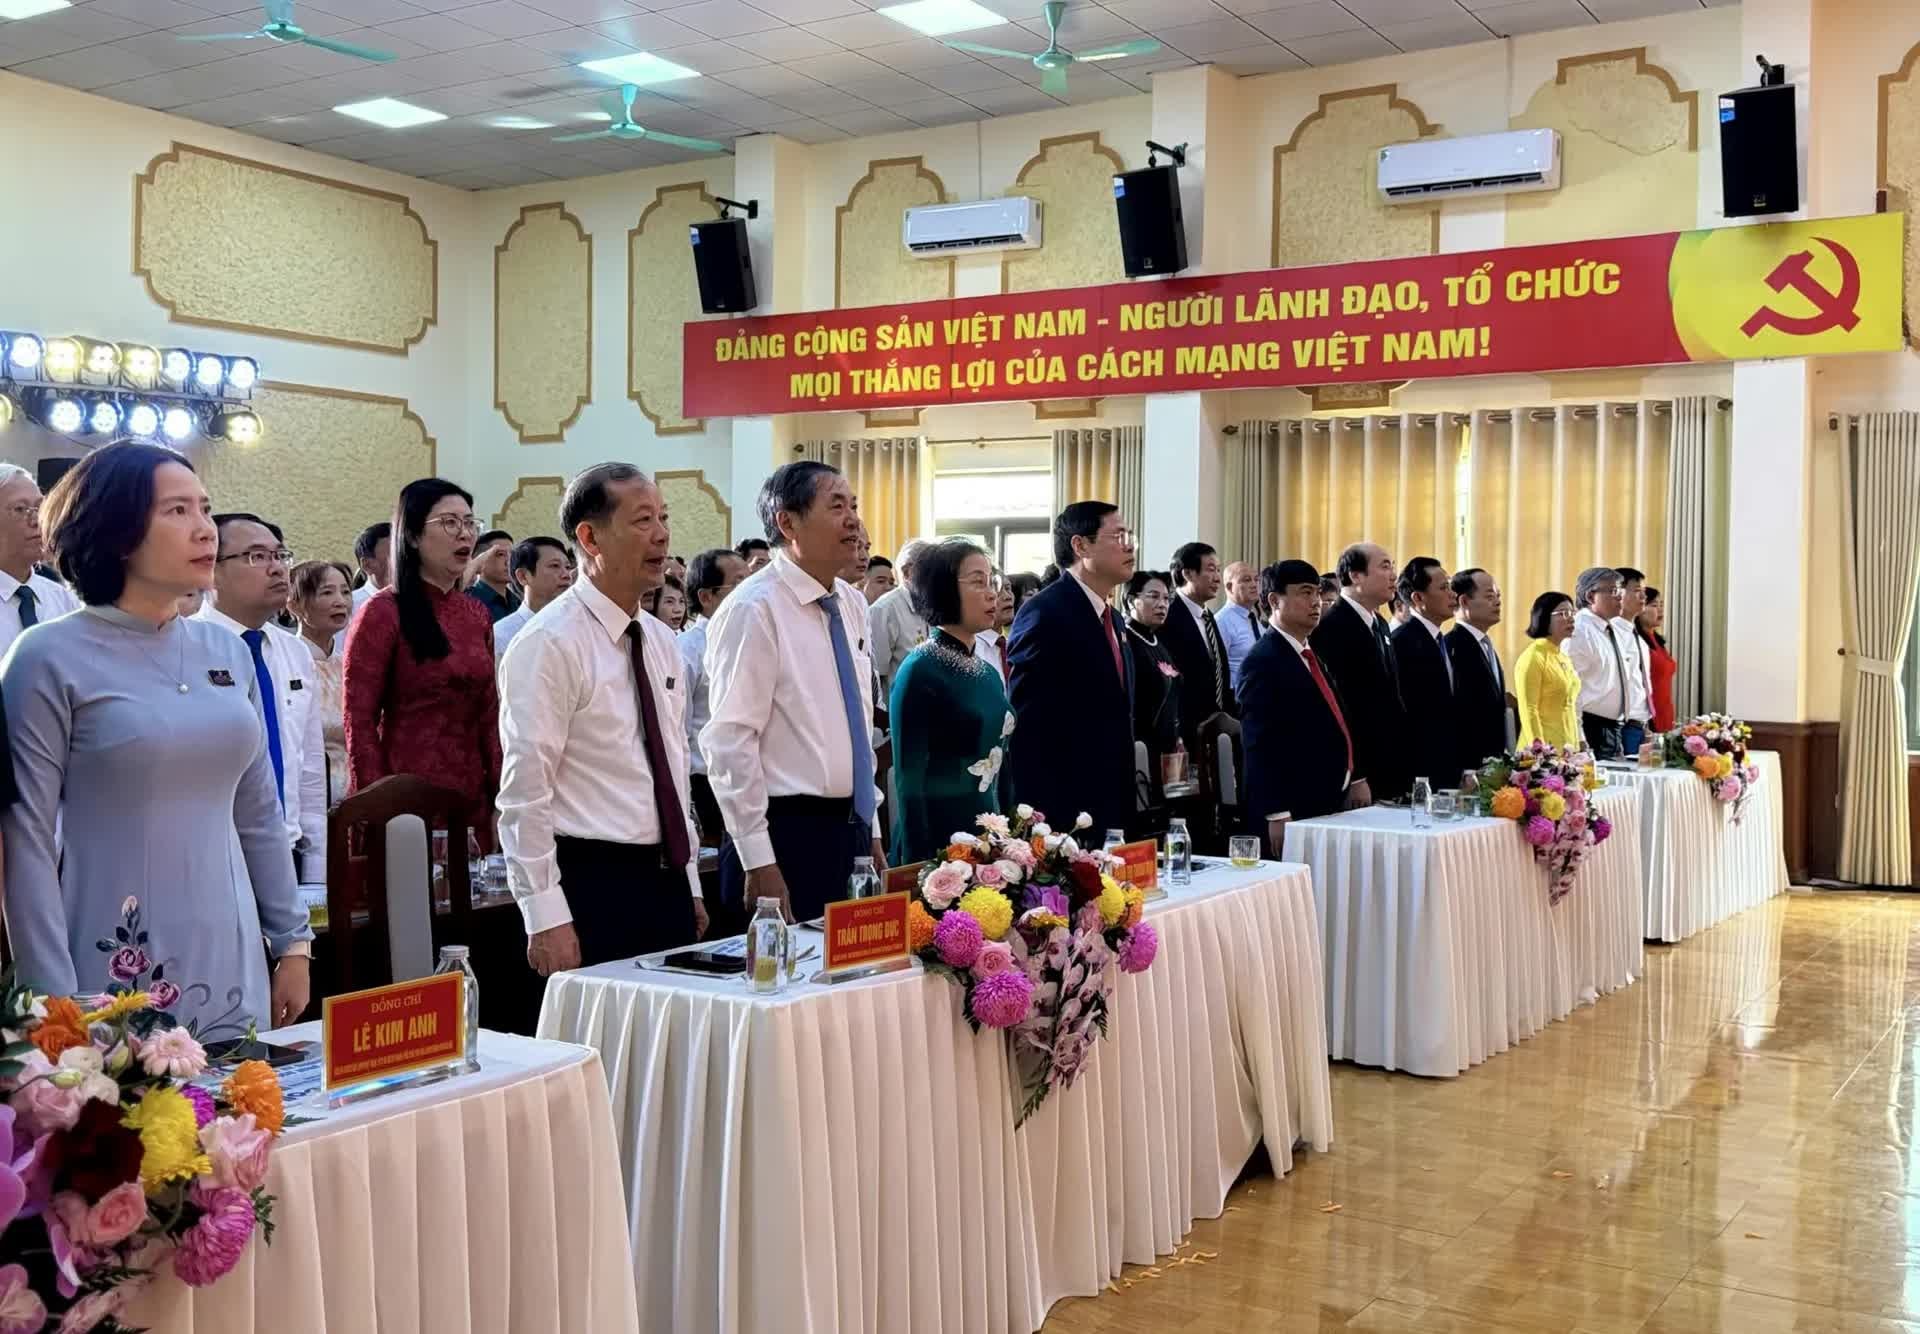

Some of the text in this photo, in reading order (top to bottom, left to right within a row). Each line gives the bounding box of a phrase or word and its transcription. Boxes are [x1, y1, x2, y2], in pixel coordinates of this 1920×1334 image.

[716, 328, 785, 362] ĐẢNG
[794, 325, 867, 360] CỘNG
[876, 315, 934, 350] SẢN
[943, 312, 1005, 348] VIỆT
[1014, 309, 1086, 339] NAM
[1120, 292, 1223, 332] NGƯỜI
[1235, 287, 1330, 323] LÃNH
[1341, 281, 1429, 319] ĐẠO,
[1443, 262, 1495, 307] TỔ
[1506, 259, 1621, 302] CHỨC
[790, 326, 1490, 402] MỌI THẮNG LỢI CỦA CÁCH MẠNG VIỆT NAM!
[371, 991, 422, 1014] ĐỒNG CHÍ
[353, 1013, 437, 1053] LÊ KIM ANH
